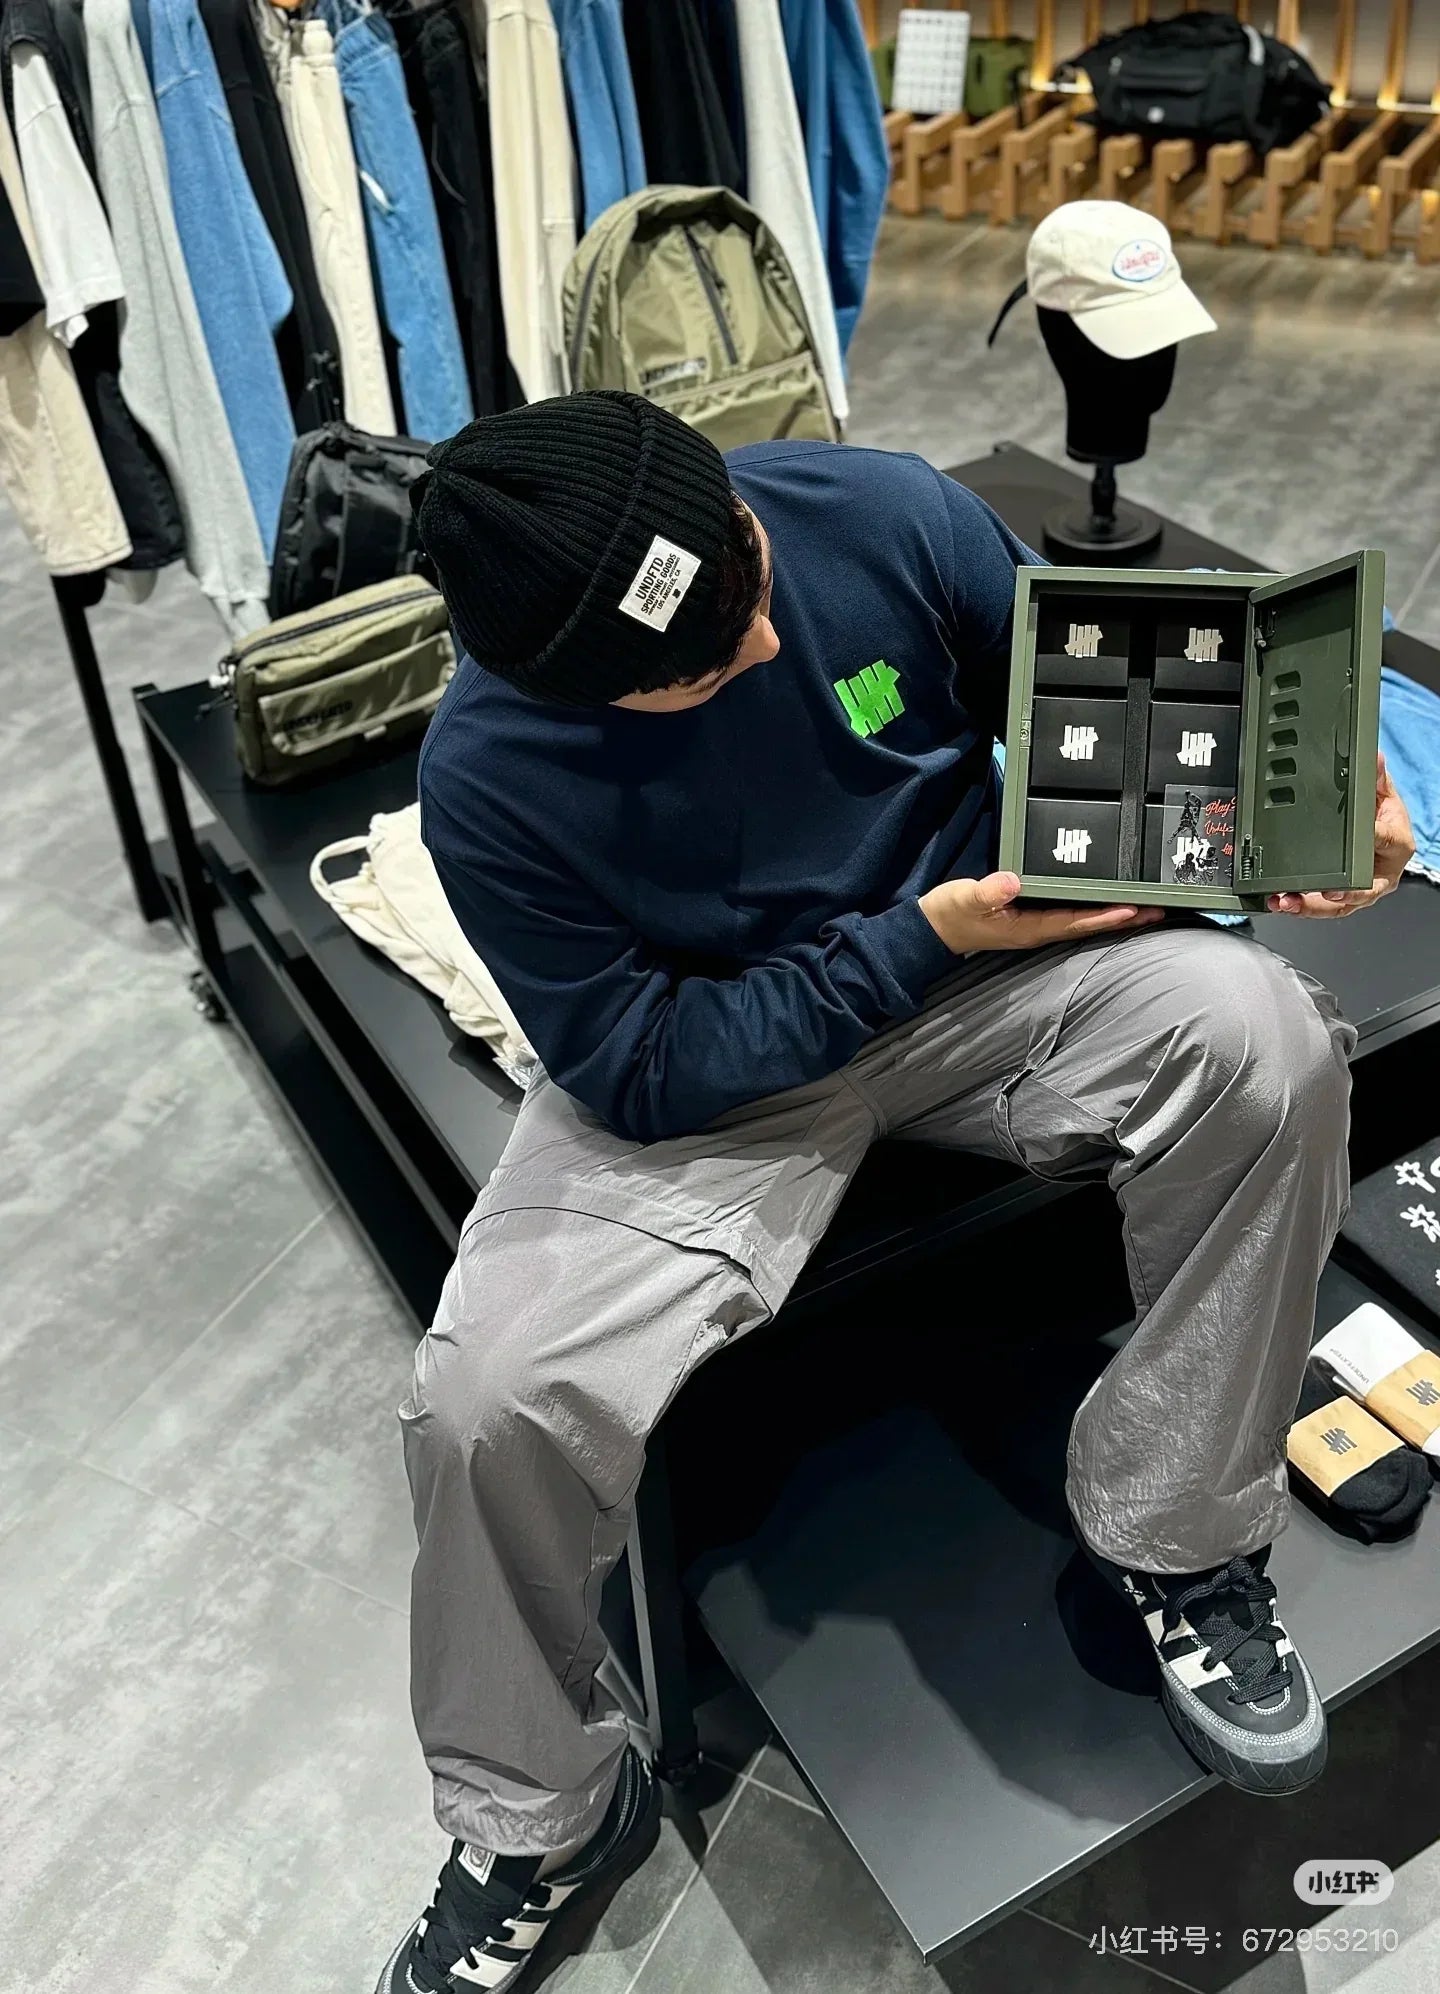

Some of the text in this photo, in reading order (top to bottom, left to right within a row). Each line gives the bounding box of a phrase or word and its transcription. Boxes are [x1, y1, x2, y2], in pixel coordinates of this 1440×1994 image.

[635, 557, 664, 600] UNDFTD
[641, 553, 677, 613] SPORTING GOODS
[657, 600, 666, 610] LOS
[674, 569, 682, 577] CA
